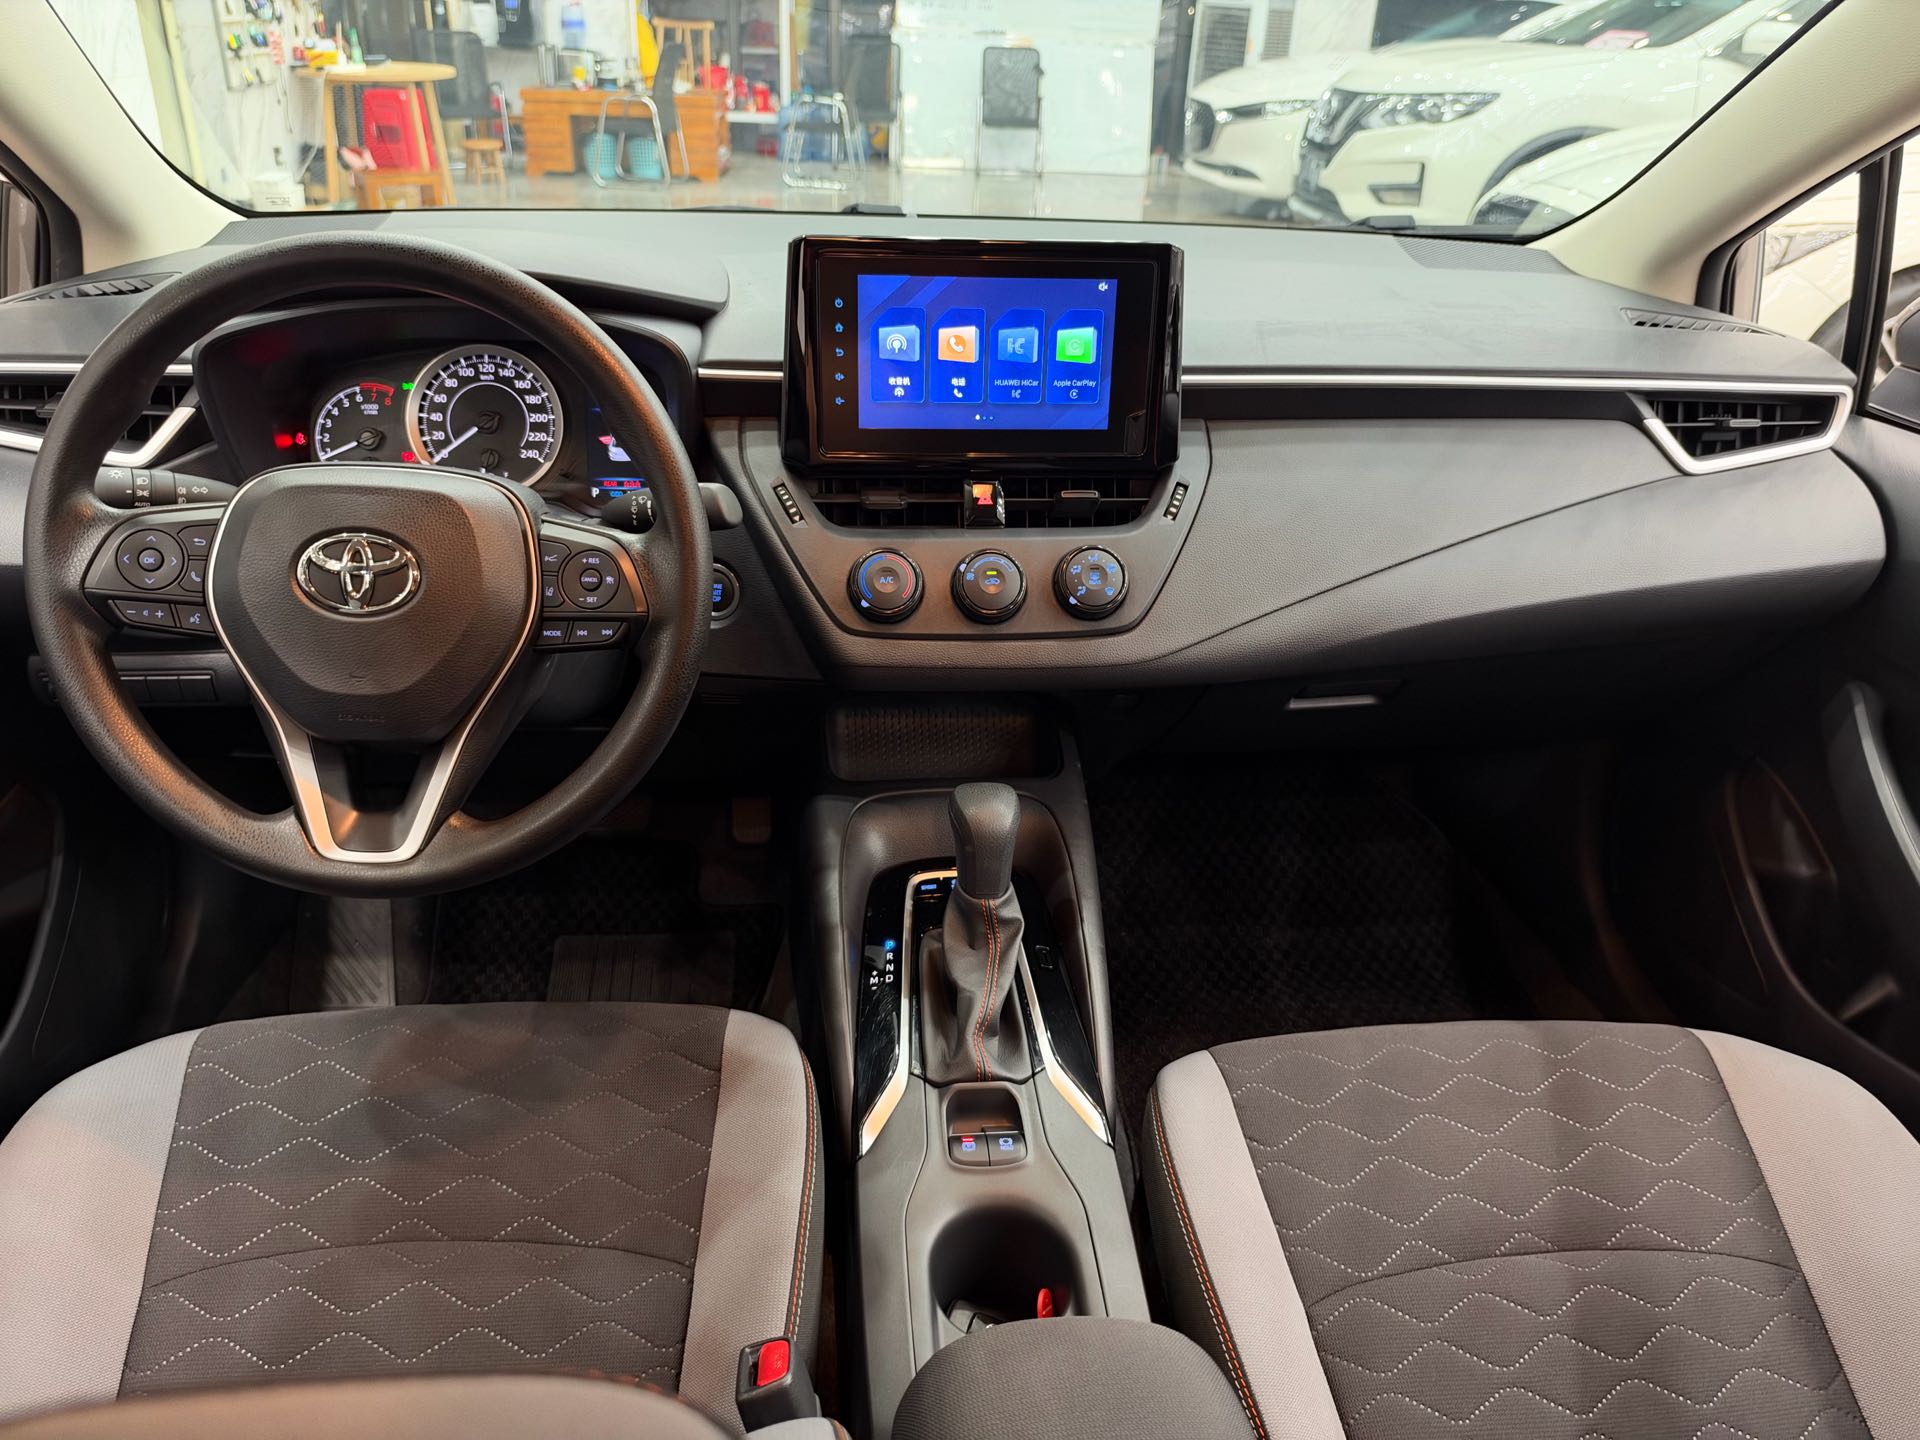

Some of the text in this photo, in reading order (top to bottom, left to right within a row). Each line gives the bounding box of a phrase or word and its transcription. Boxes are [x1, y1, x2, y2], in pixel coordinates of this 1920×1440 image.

[458, 368, 475, 377] 100
[478, 364, 495, 373] 120
[498, 368, 516, 377] 140
[445, 379, 458, 388] 80
[514, 380, 531, 389] 160
[1053, 379, 1096, 388] Apple CarPlay
[343, 399, 350, 407] 5
[385, 398, 392, 406] 8
[434, 394, 447, 403] 60
[524, 395, 542, 404] 180
[332, 407, 339, 416] 4
[430, 413, 443, 422] 40
[530, 414, 548, 422] 200
[325, 419, 332, 428] 3
[323, 434, 330, 442] 2
[432, 431, 445, 440] 20
[528, 432, 547, 441] 220
[520, 450, 539, 459] 240
[591, 487, 600, 498] P
[886, 952, 894, 960] R
[886, 963, 894, 972] N
[870, 976, 878, 985] M
[886, 974, 894, 983] D
